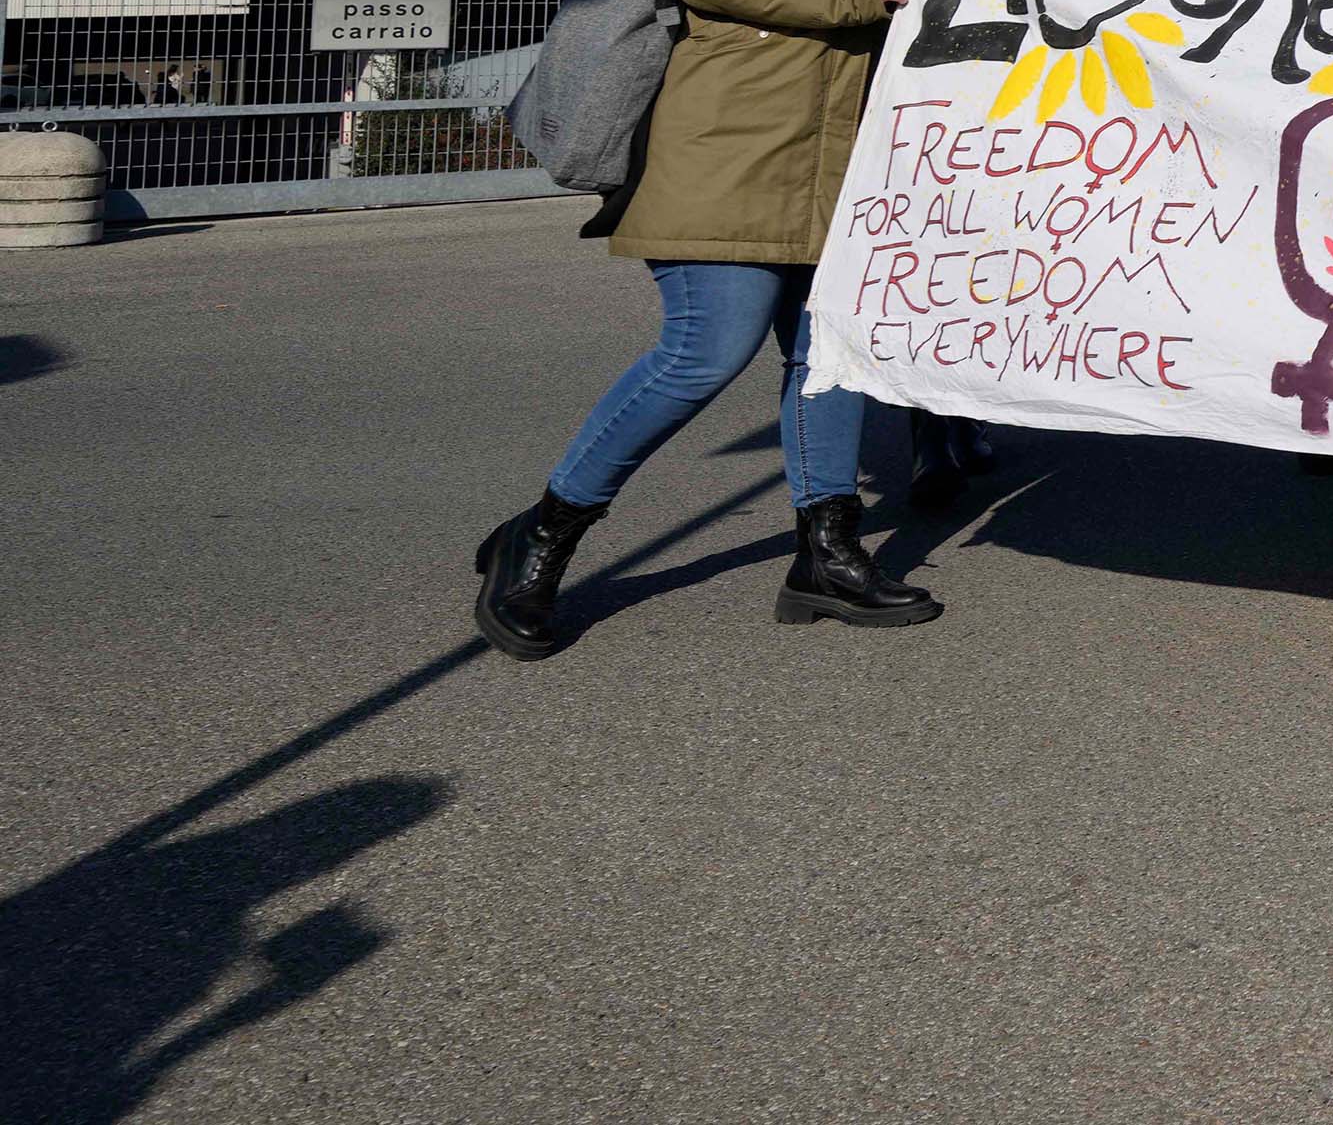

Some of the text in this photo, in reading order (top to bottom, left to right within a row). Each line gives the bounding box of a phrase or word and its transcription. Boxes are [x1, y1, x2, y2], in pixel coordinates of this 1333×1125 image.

[332, 23, 432, 39] carraio
[344, 4, 424, 20] passo
[885, 100, 1218, 193] FREEDOM
[848, 183, 1259, 254] FOR ALL WOMEN
[855, 241, 1192, 325] FREEDOM
[870, 314, 1194, 390] EVERYWHERE
